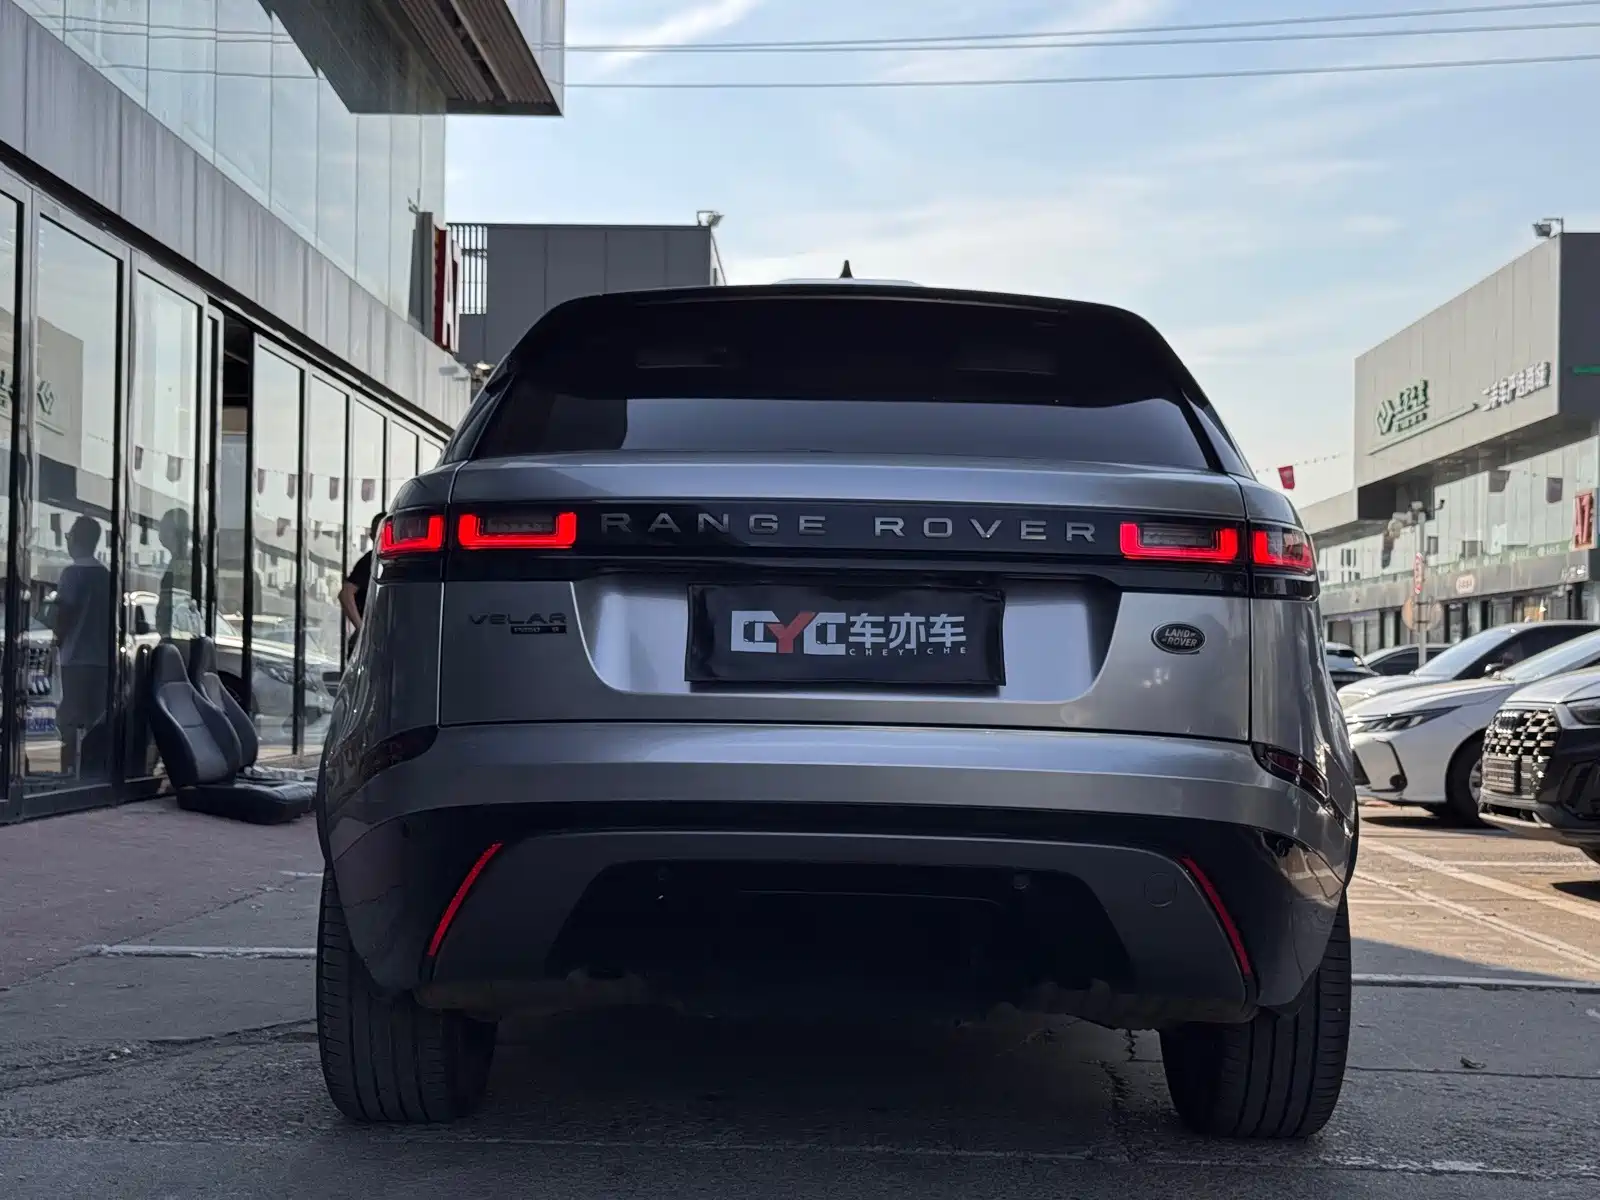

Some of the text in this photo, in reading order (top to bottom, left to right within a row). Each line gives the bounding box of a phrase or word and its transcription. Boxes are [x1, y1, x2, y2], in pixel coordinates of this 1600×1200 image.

[600, 513, 1097, 542] RANGE ROVER
[469, 613, 567, 625] VELAR
[848, 612, 967, 649] 车亦车
[1165, 628, 1191, 637] LAND
[1167, 637, 1198, 646] ROVER
[849, 646, 967, 656] CHEYICHE
